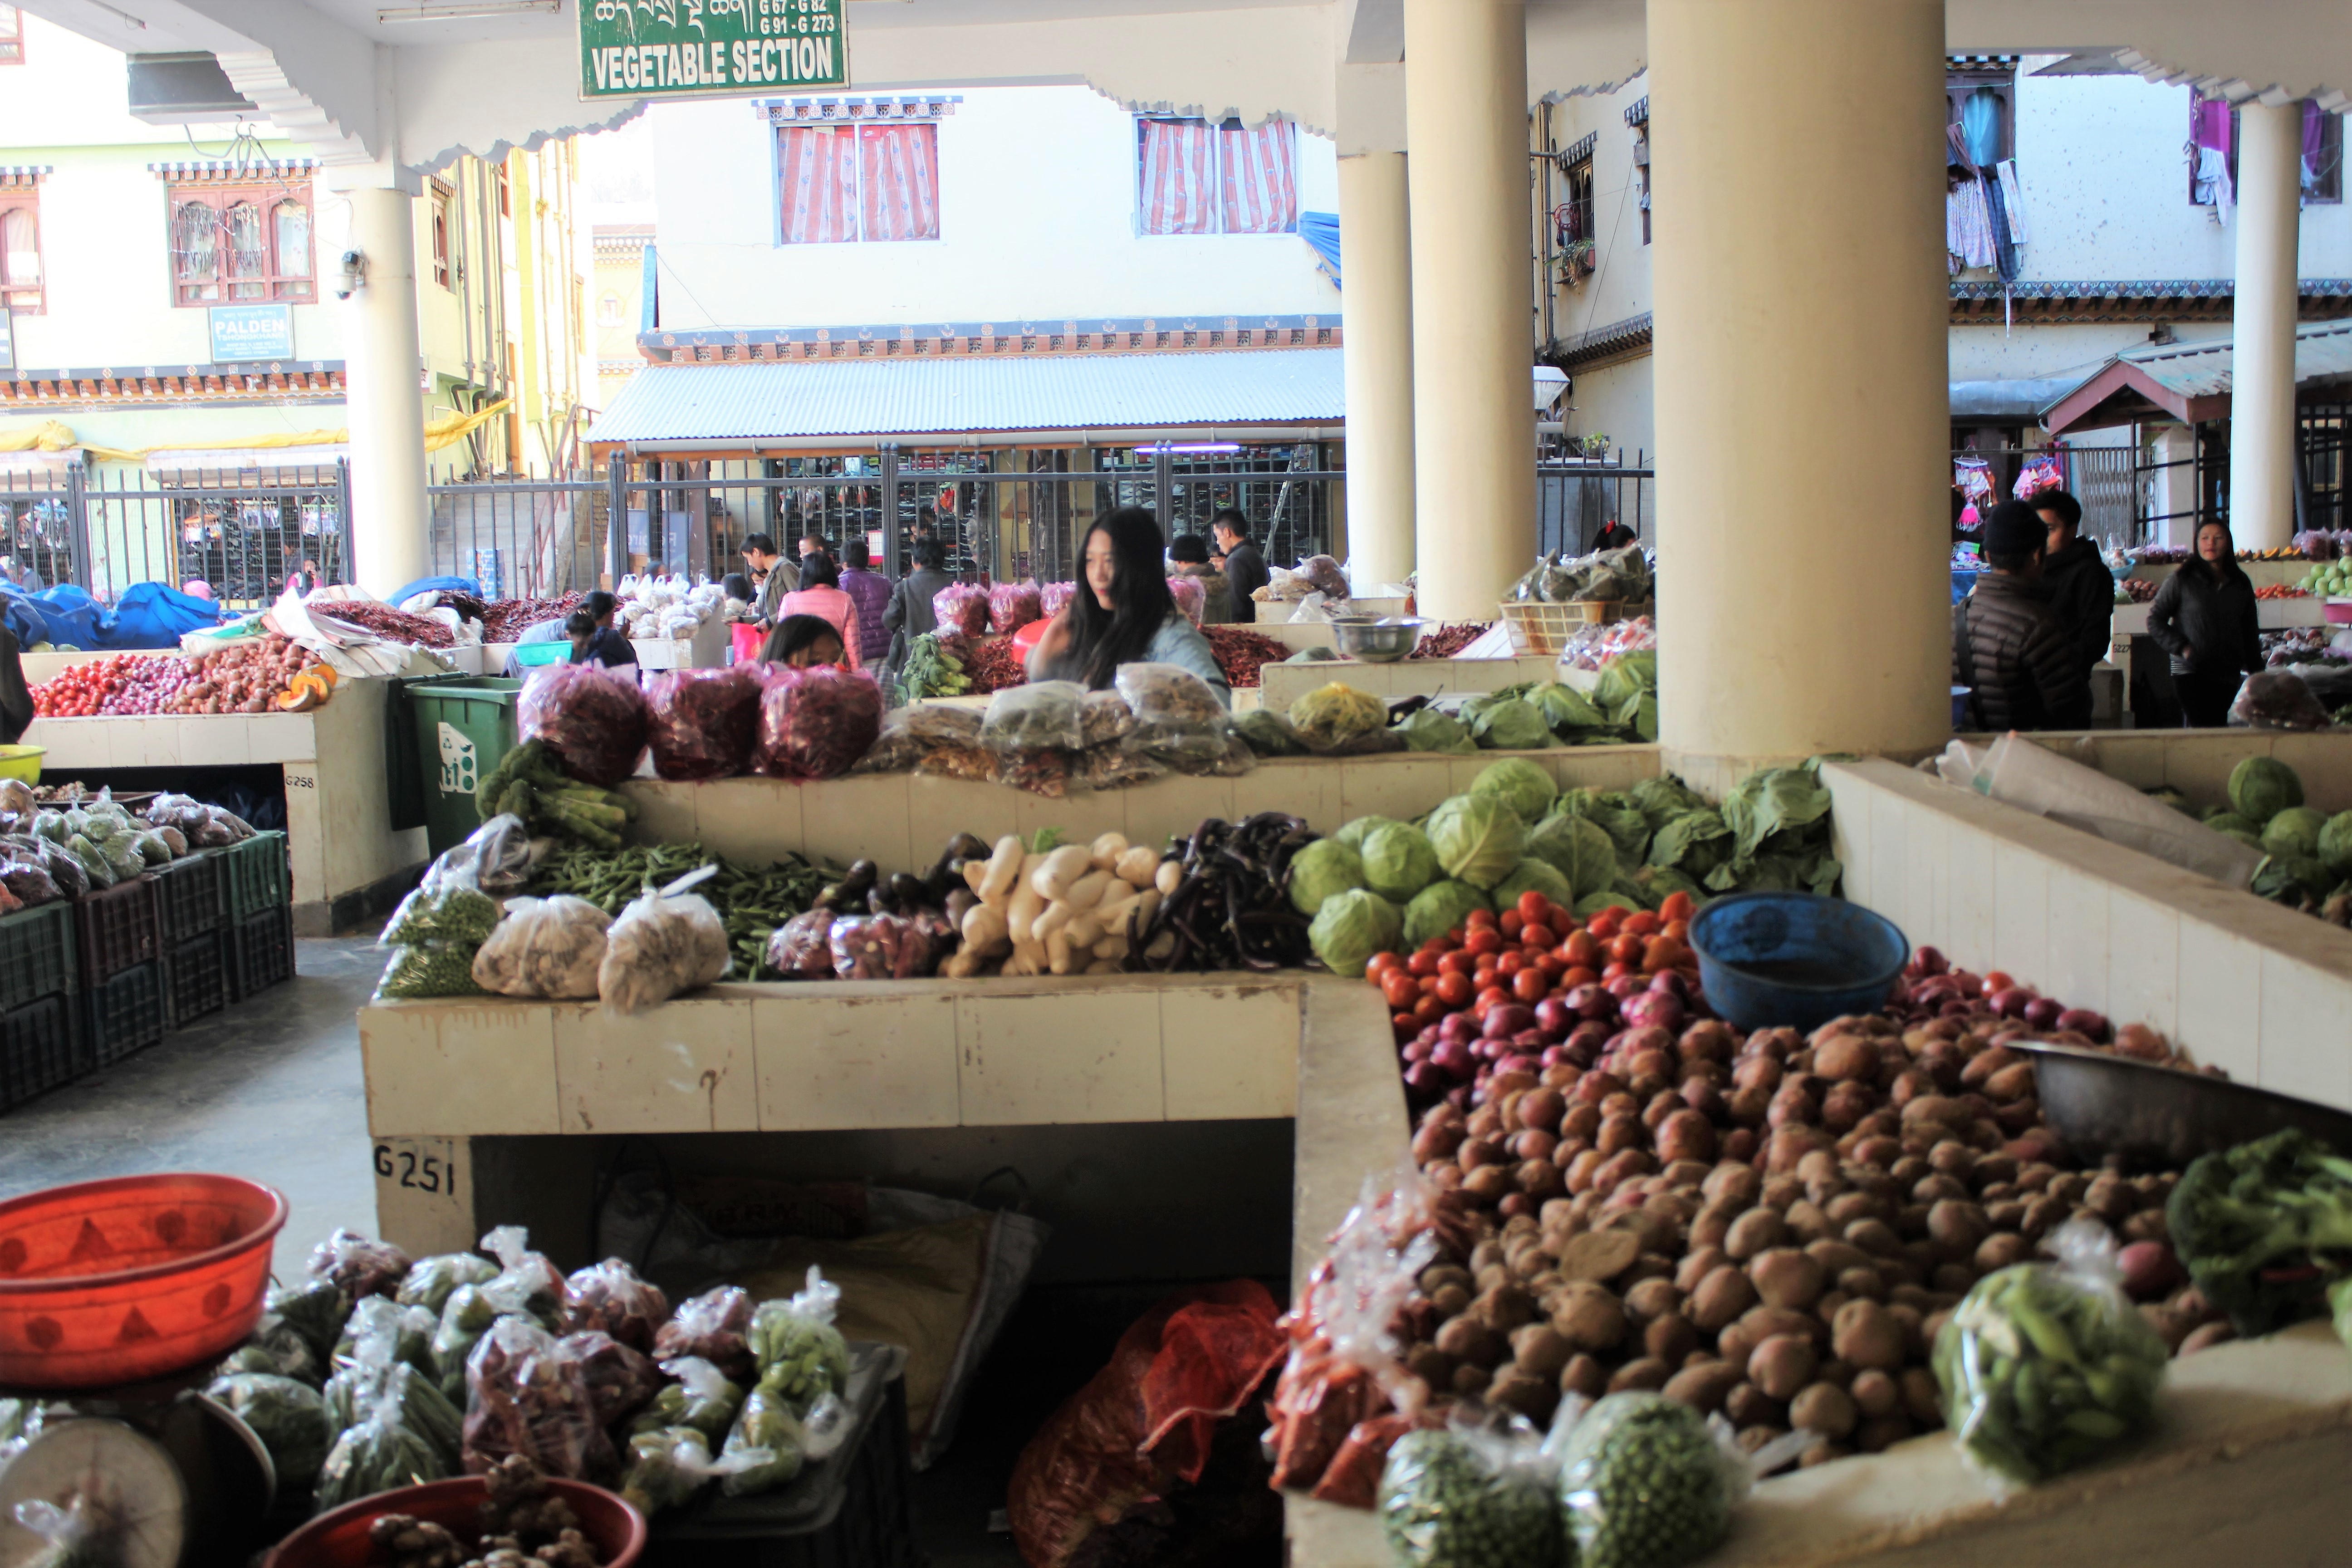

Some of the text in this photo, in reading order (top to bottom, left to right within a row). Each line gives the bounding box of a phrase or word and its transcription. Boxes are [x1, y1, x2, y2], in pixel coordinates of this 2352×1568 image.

[759, 0, 769, 15] G
[772, 0, 787, 14] 67
[798, 0, 808, 14] G
[811, 0, 827, 13] 82
[760, 16, 770, 35] G
[773, 16, 787, 34] 91
[798, 15, 808, 34] G
[812, 14, 834, 33] 273
[591, 36, 833, 90] VEGETABLE SECTION
[215, 318, 284, 335] PALDEN
[216, 332, 285, 341] TSHONGKHANG
[285, 776, 314, 788] G258
[374, 1145, 453, 1195] G251
